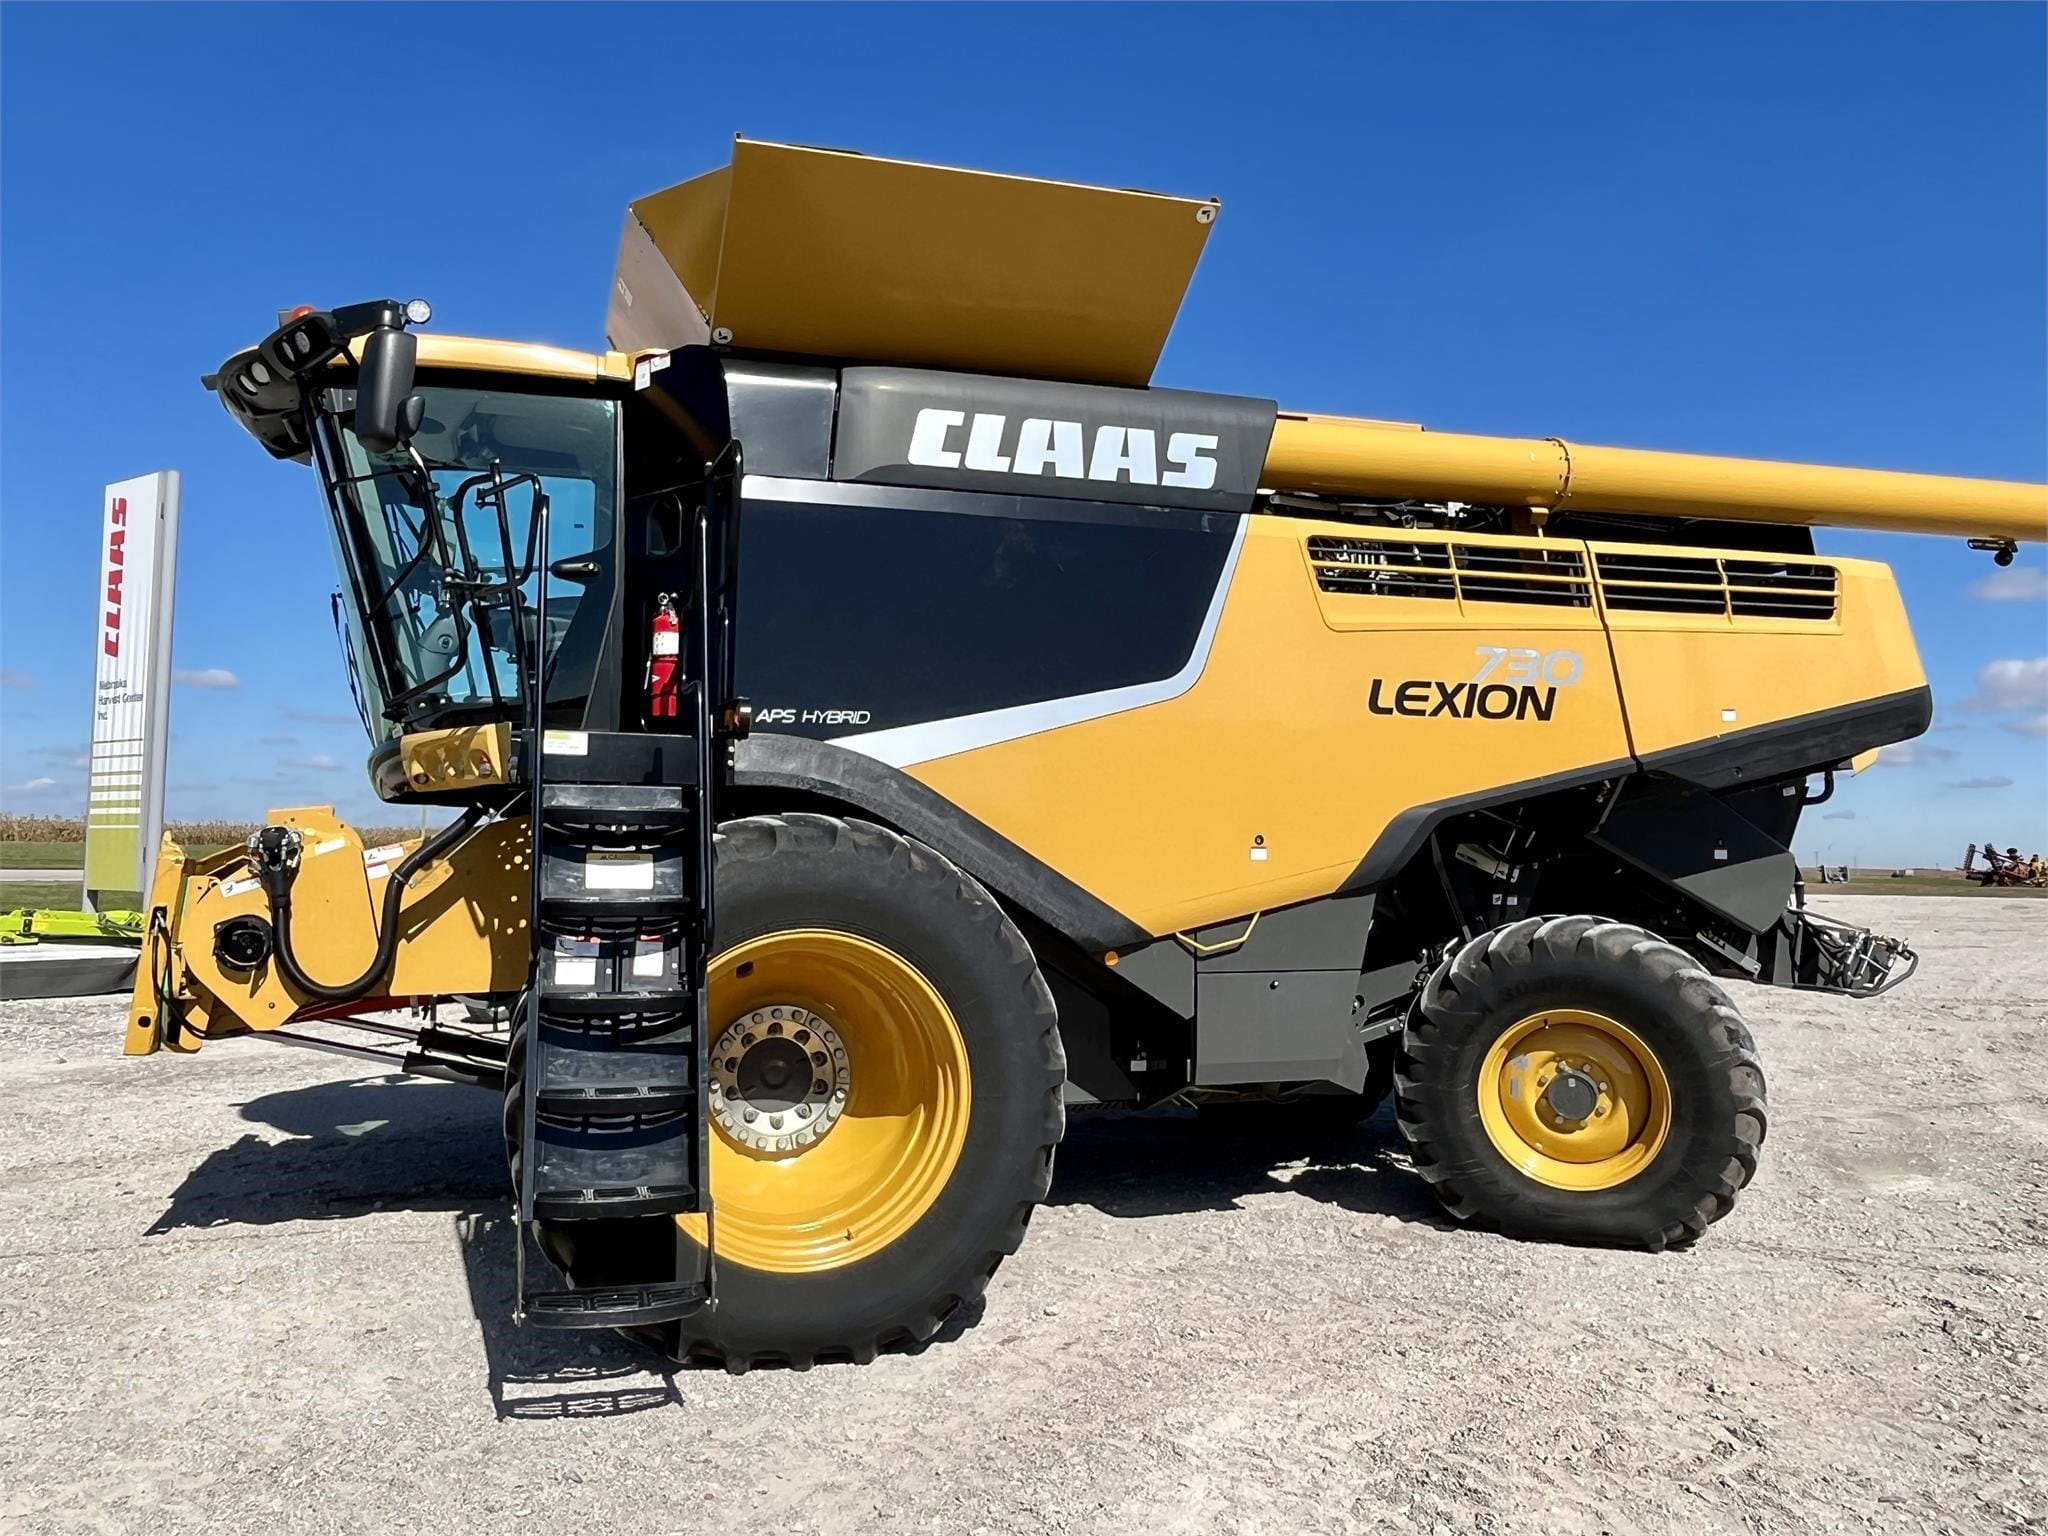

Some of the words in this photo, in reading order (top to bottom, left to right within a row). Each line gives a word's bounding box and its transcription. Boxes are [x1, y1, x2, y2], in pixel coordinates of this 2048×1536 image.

[908, 408, 1219, 489] CLAAS
[104, 497, 128, 658] CLAAS
[1471, 646, 1583, 687] 730
[755, 708, 797, 723] APS
[801, 709, 871, 724] HYBRID
[1368, 678, 1557, 721] LEXION
